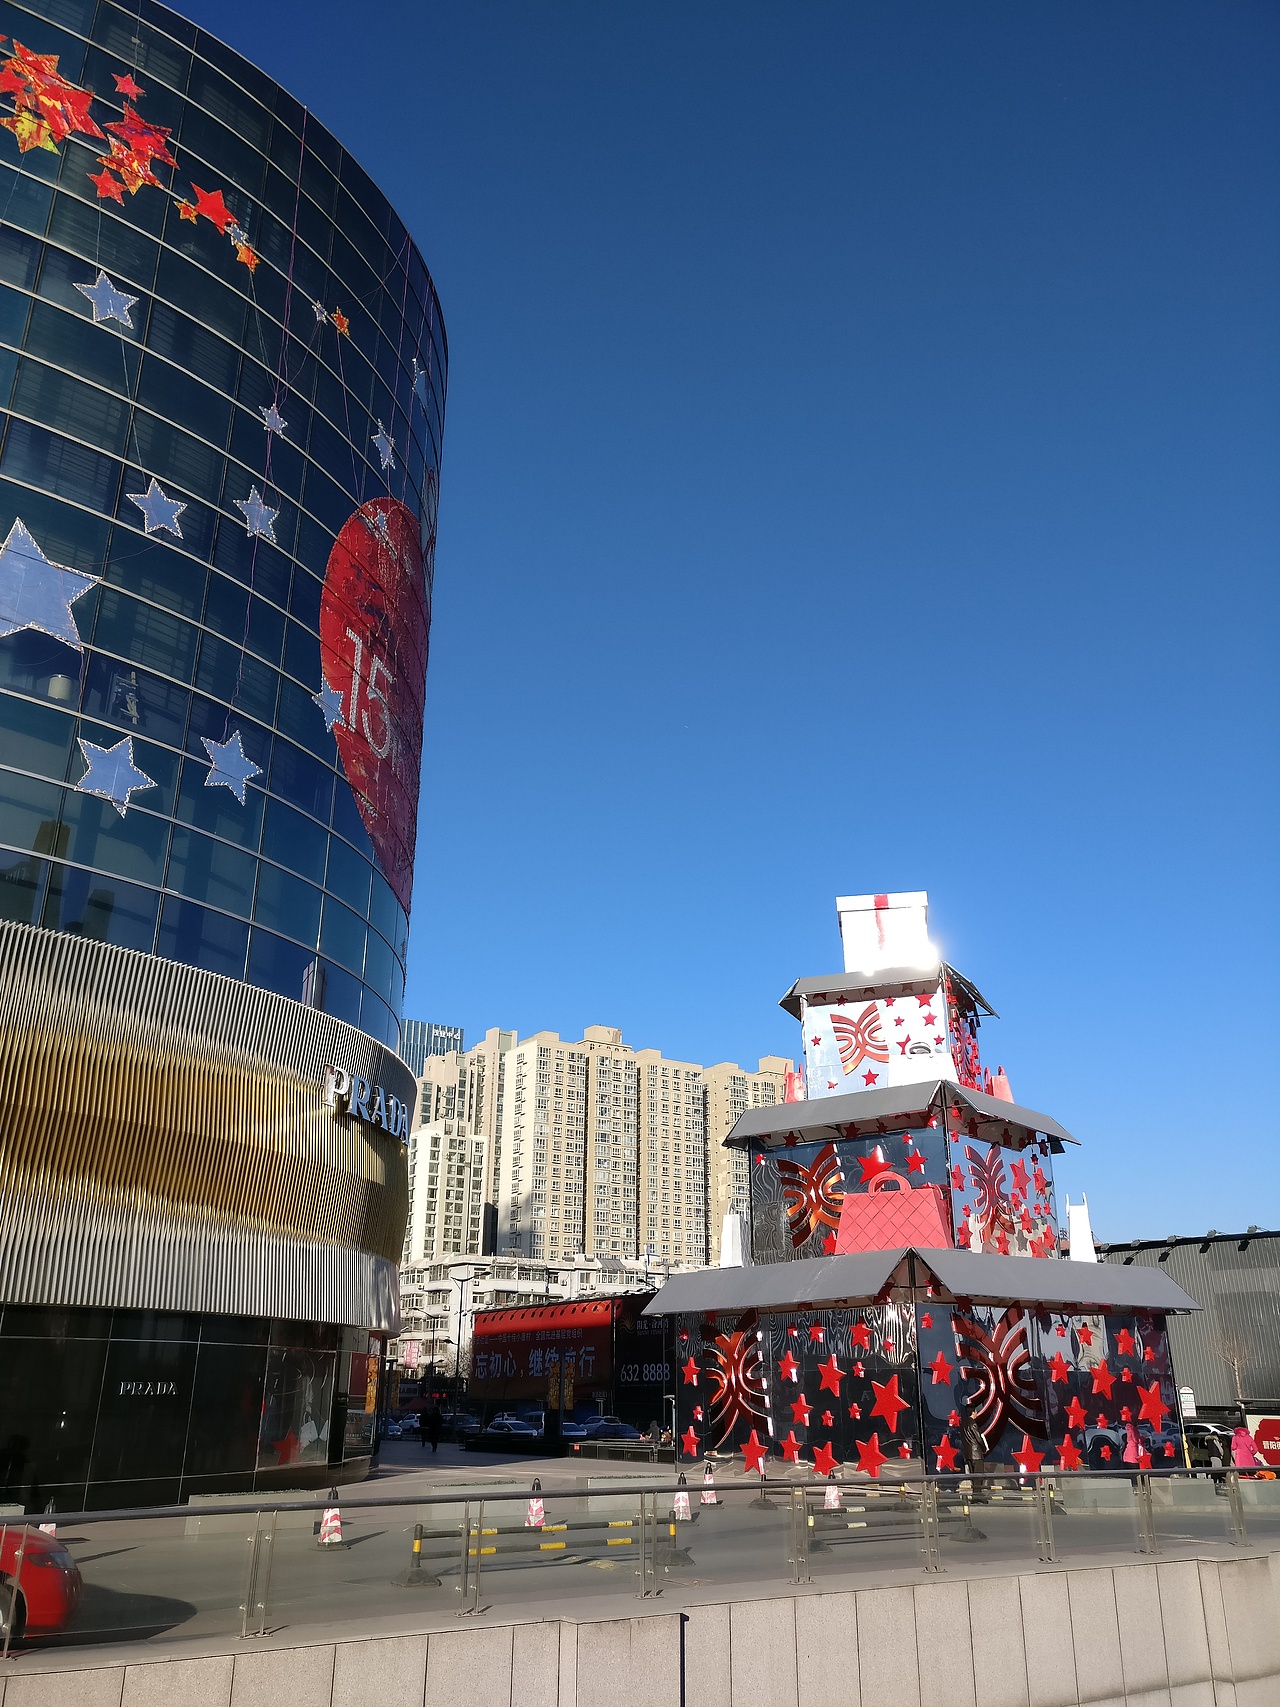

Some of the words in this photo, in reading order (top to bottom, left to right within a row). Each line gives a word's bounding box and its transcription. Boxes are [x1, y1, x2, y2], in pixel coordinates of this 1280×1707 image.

[321, 1063, 409, 1145] PRADA
[620, 1364, 639, 1382] 632
[643, 1363, 670, 1381] 8888
[119, 1381, 179, 1395] PRADA
